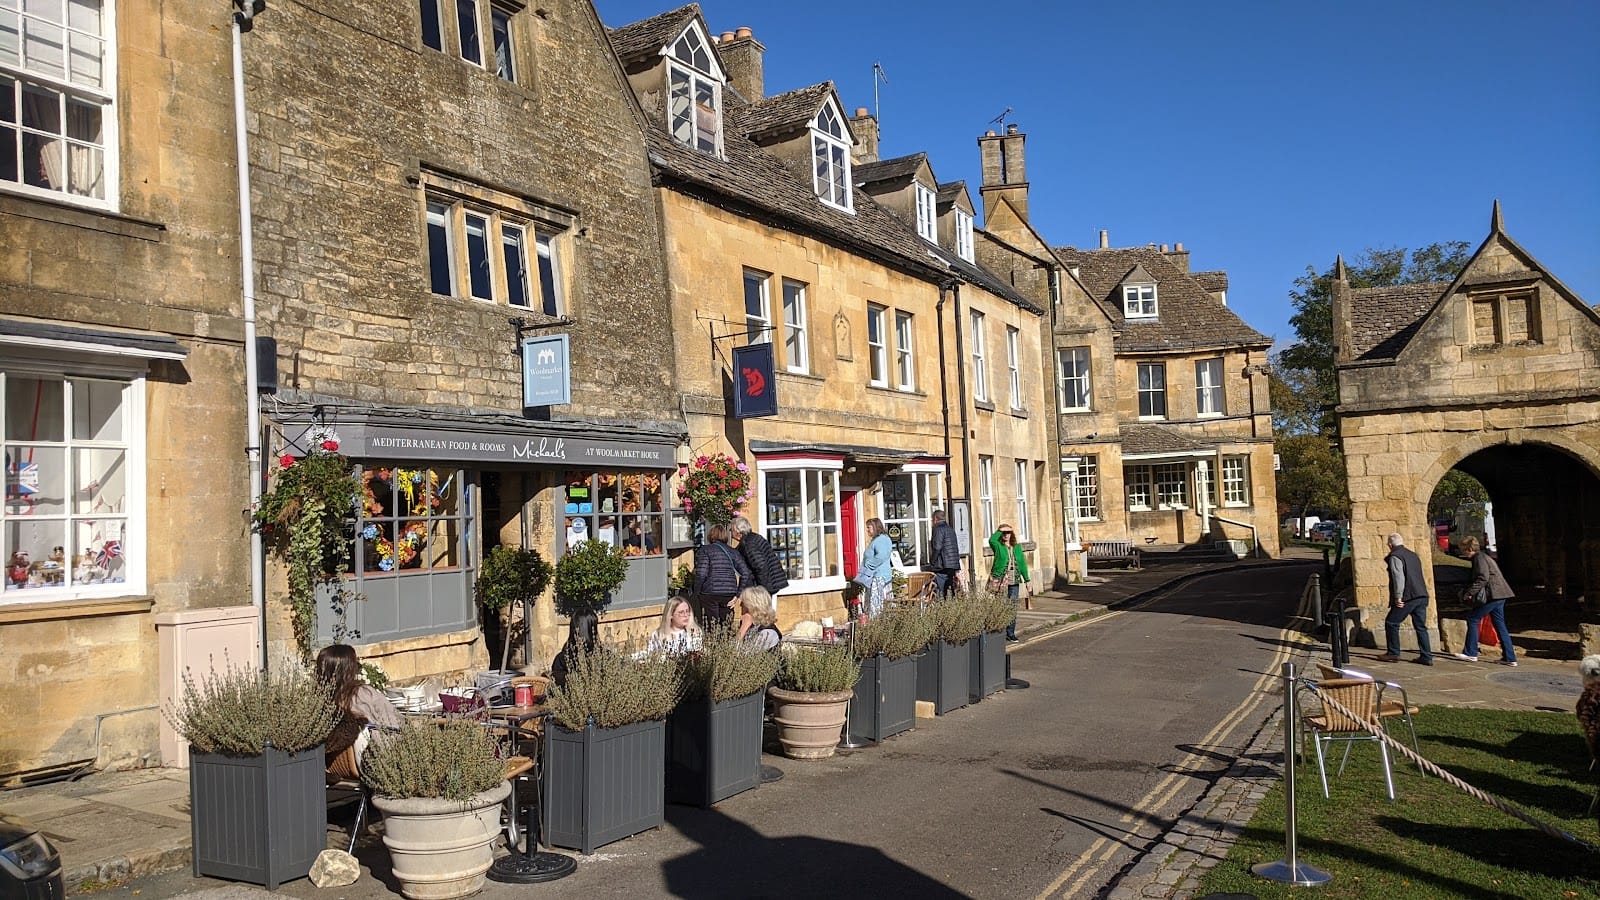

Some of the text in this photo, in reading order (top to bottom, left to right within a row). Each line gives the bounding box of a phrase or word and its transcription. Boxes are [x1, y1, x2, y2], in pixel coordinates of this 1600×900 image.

[372, 437, 506, 452] MEDITERRANEAN FOOD & ROOMS
[512, 437, 566, 459] Michael's
[585, 447, 660, 459] AT WOOLMARKET HOUSE
